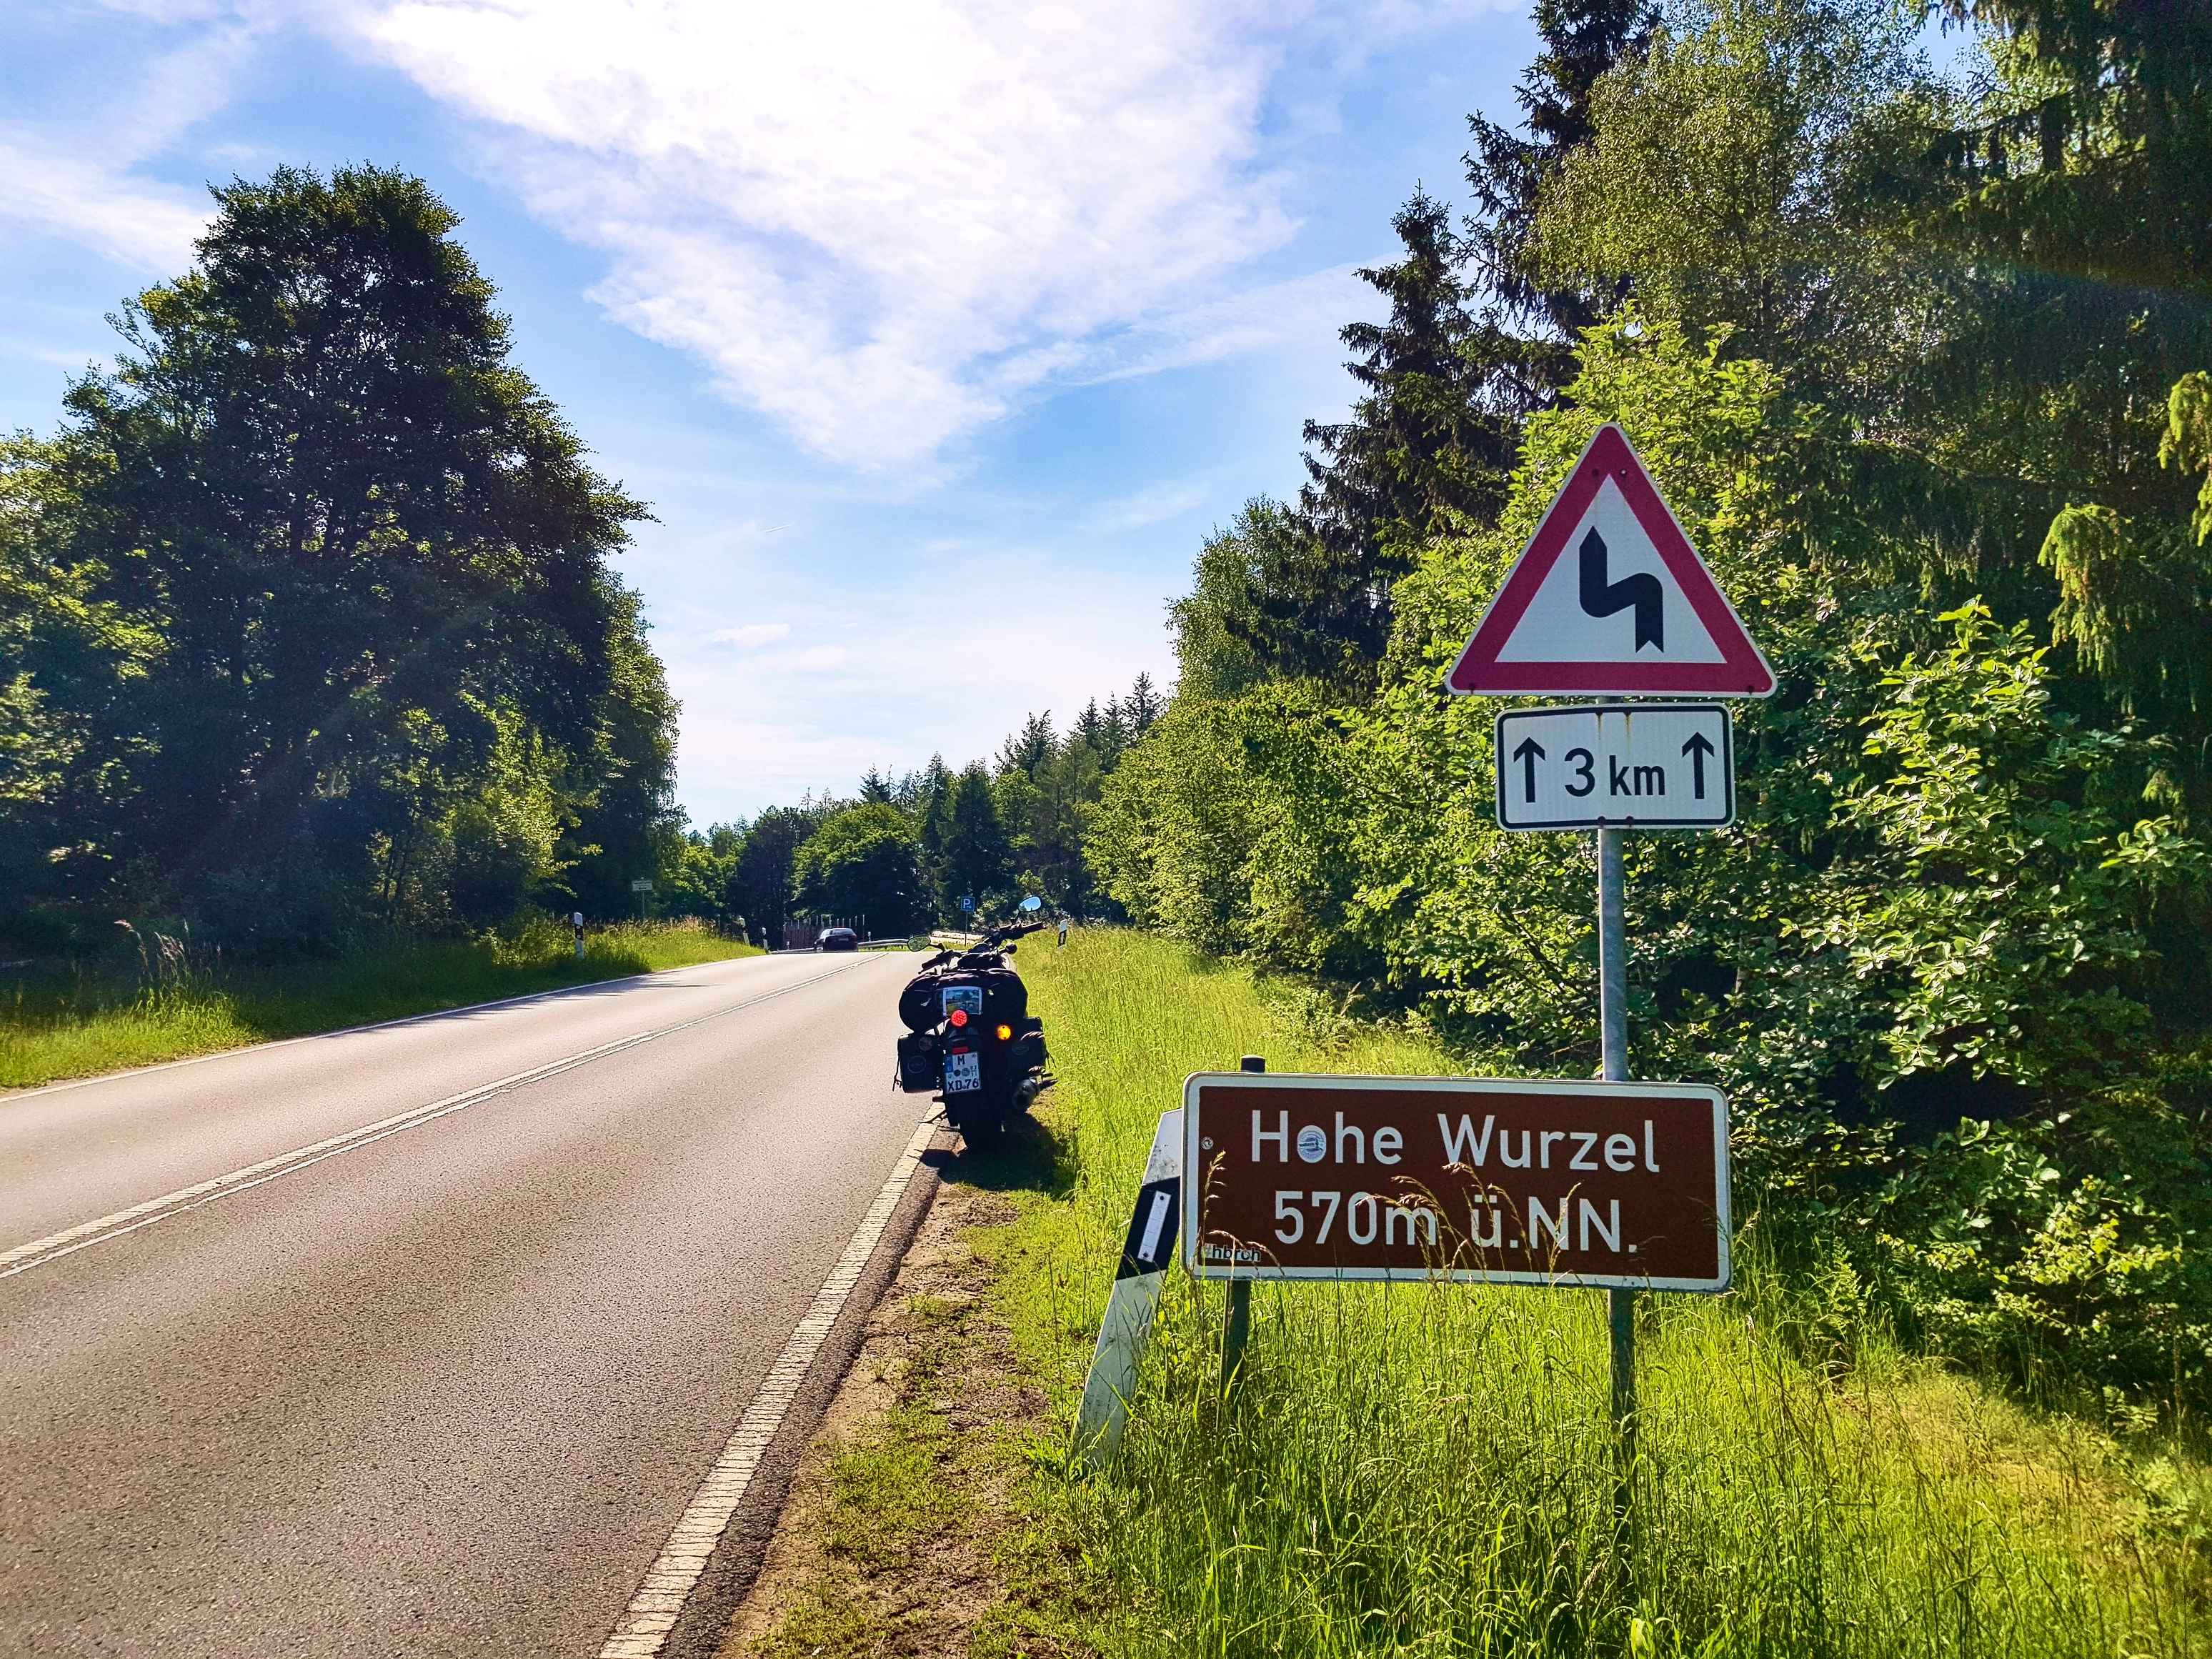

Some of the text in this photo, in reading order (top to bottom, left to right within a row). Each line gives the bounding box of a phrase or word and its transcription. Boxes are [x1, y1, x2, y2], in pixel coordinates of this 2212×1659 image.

[1564, 747, 1665, 797] 3 km
[963, 898, 971, 909] P
[957, 1055, 965, 1065] M
[1251, 1110, 1403, 1165] Hohe
[1437, 1113, 1660, 1173] Wurzel
[1275, 1190, 1437, 1246] 570m
